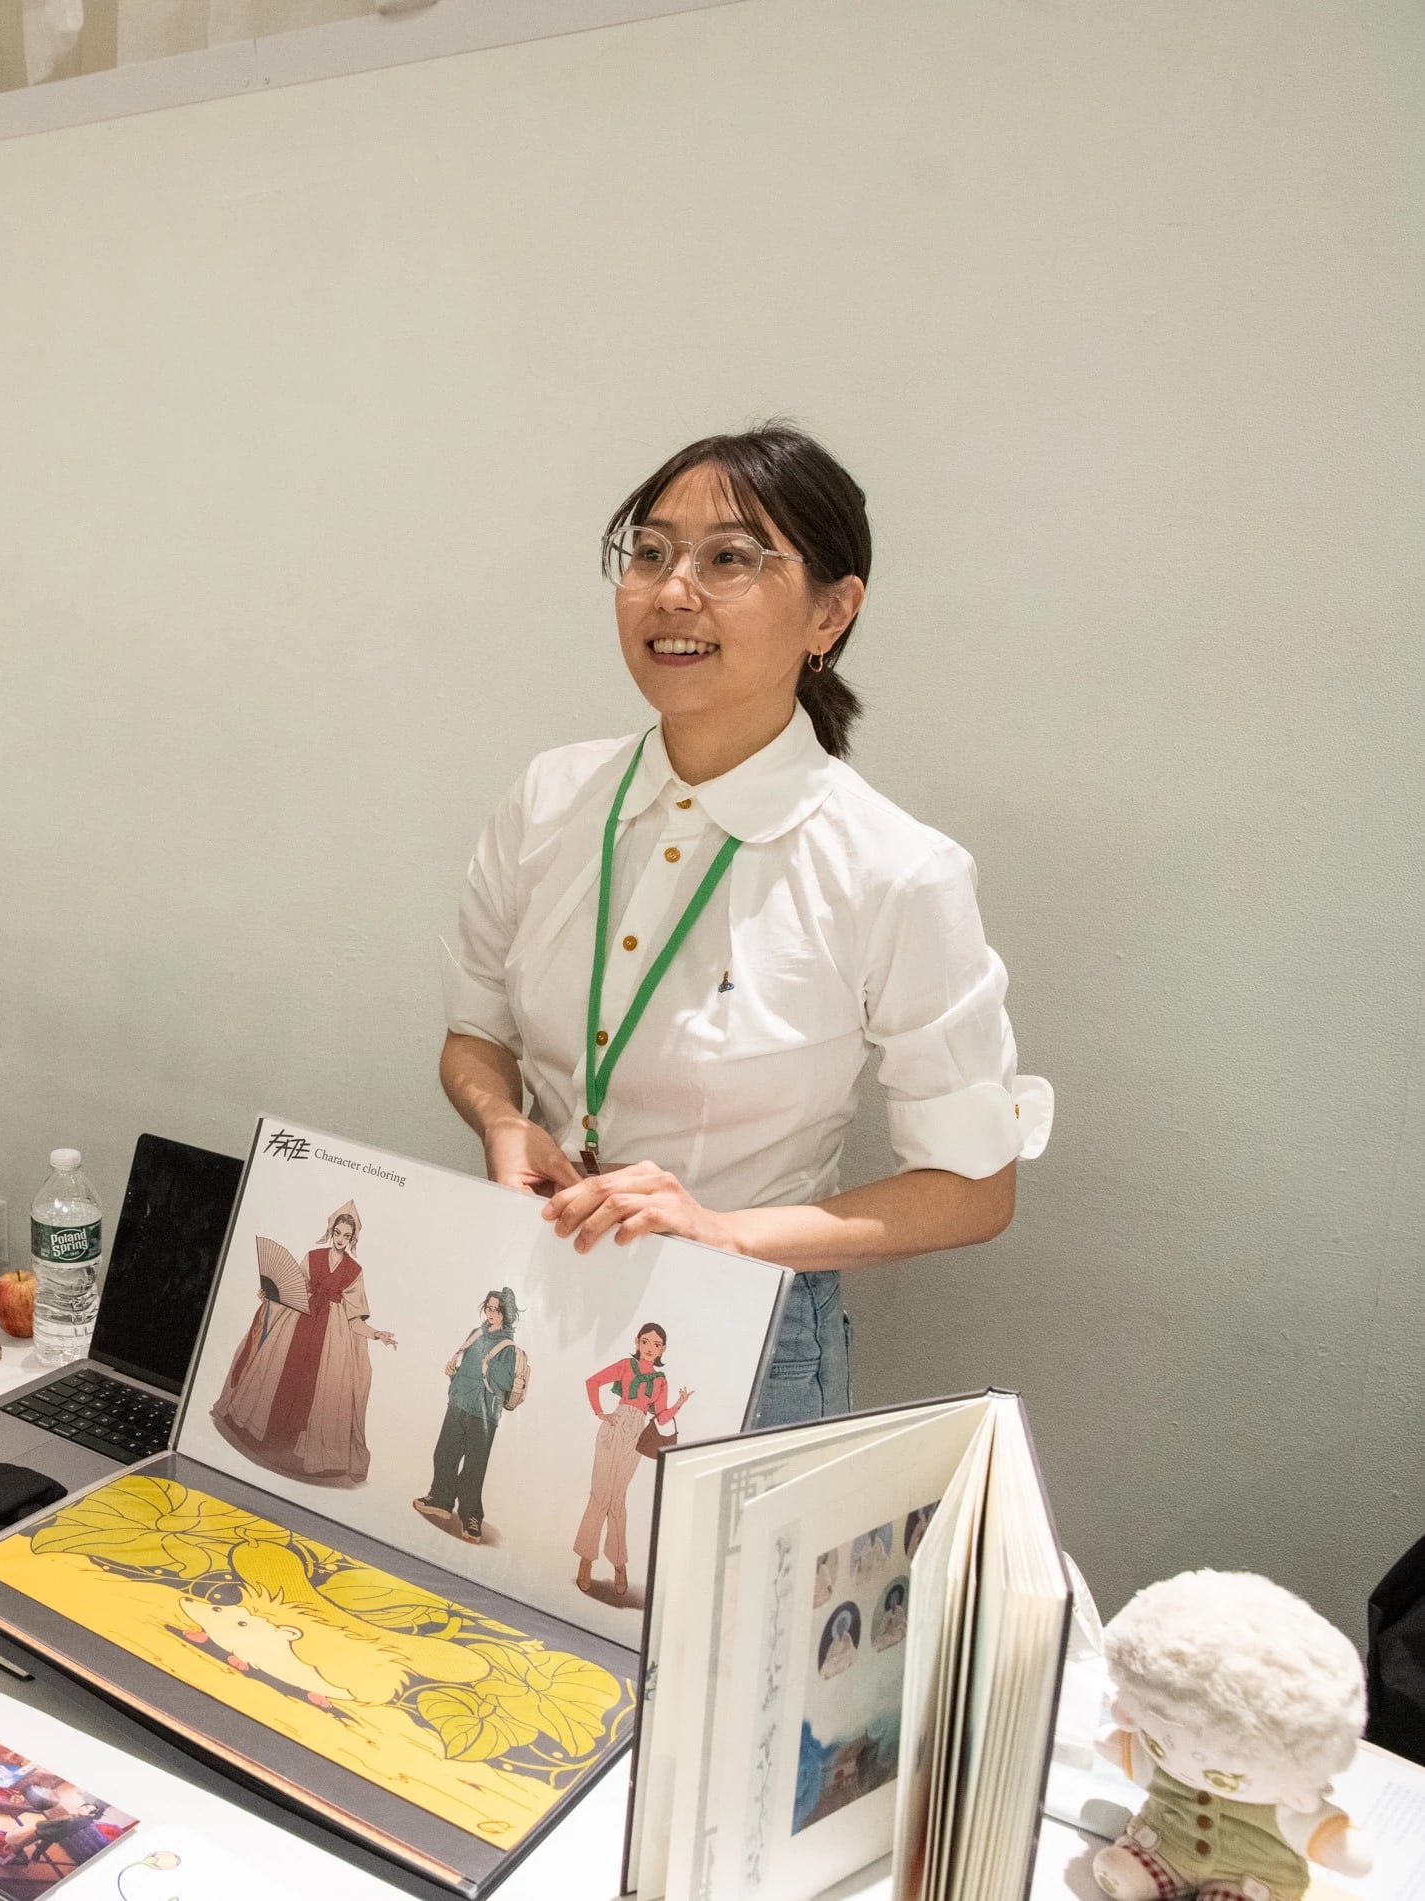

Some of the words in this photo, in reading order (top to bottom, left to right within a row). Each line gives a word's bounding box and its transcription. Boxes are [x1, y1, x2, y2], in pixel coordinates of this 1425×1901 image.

[263, 1128, 311, 1161] FATE
[314, 1148, 361, 1171] Character
[362, 1163, 407, 1188] cloloring
[50, 1228, 87, 1246] Poland
[52, 1239, 89, 1257] Spring
